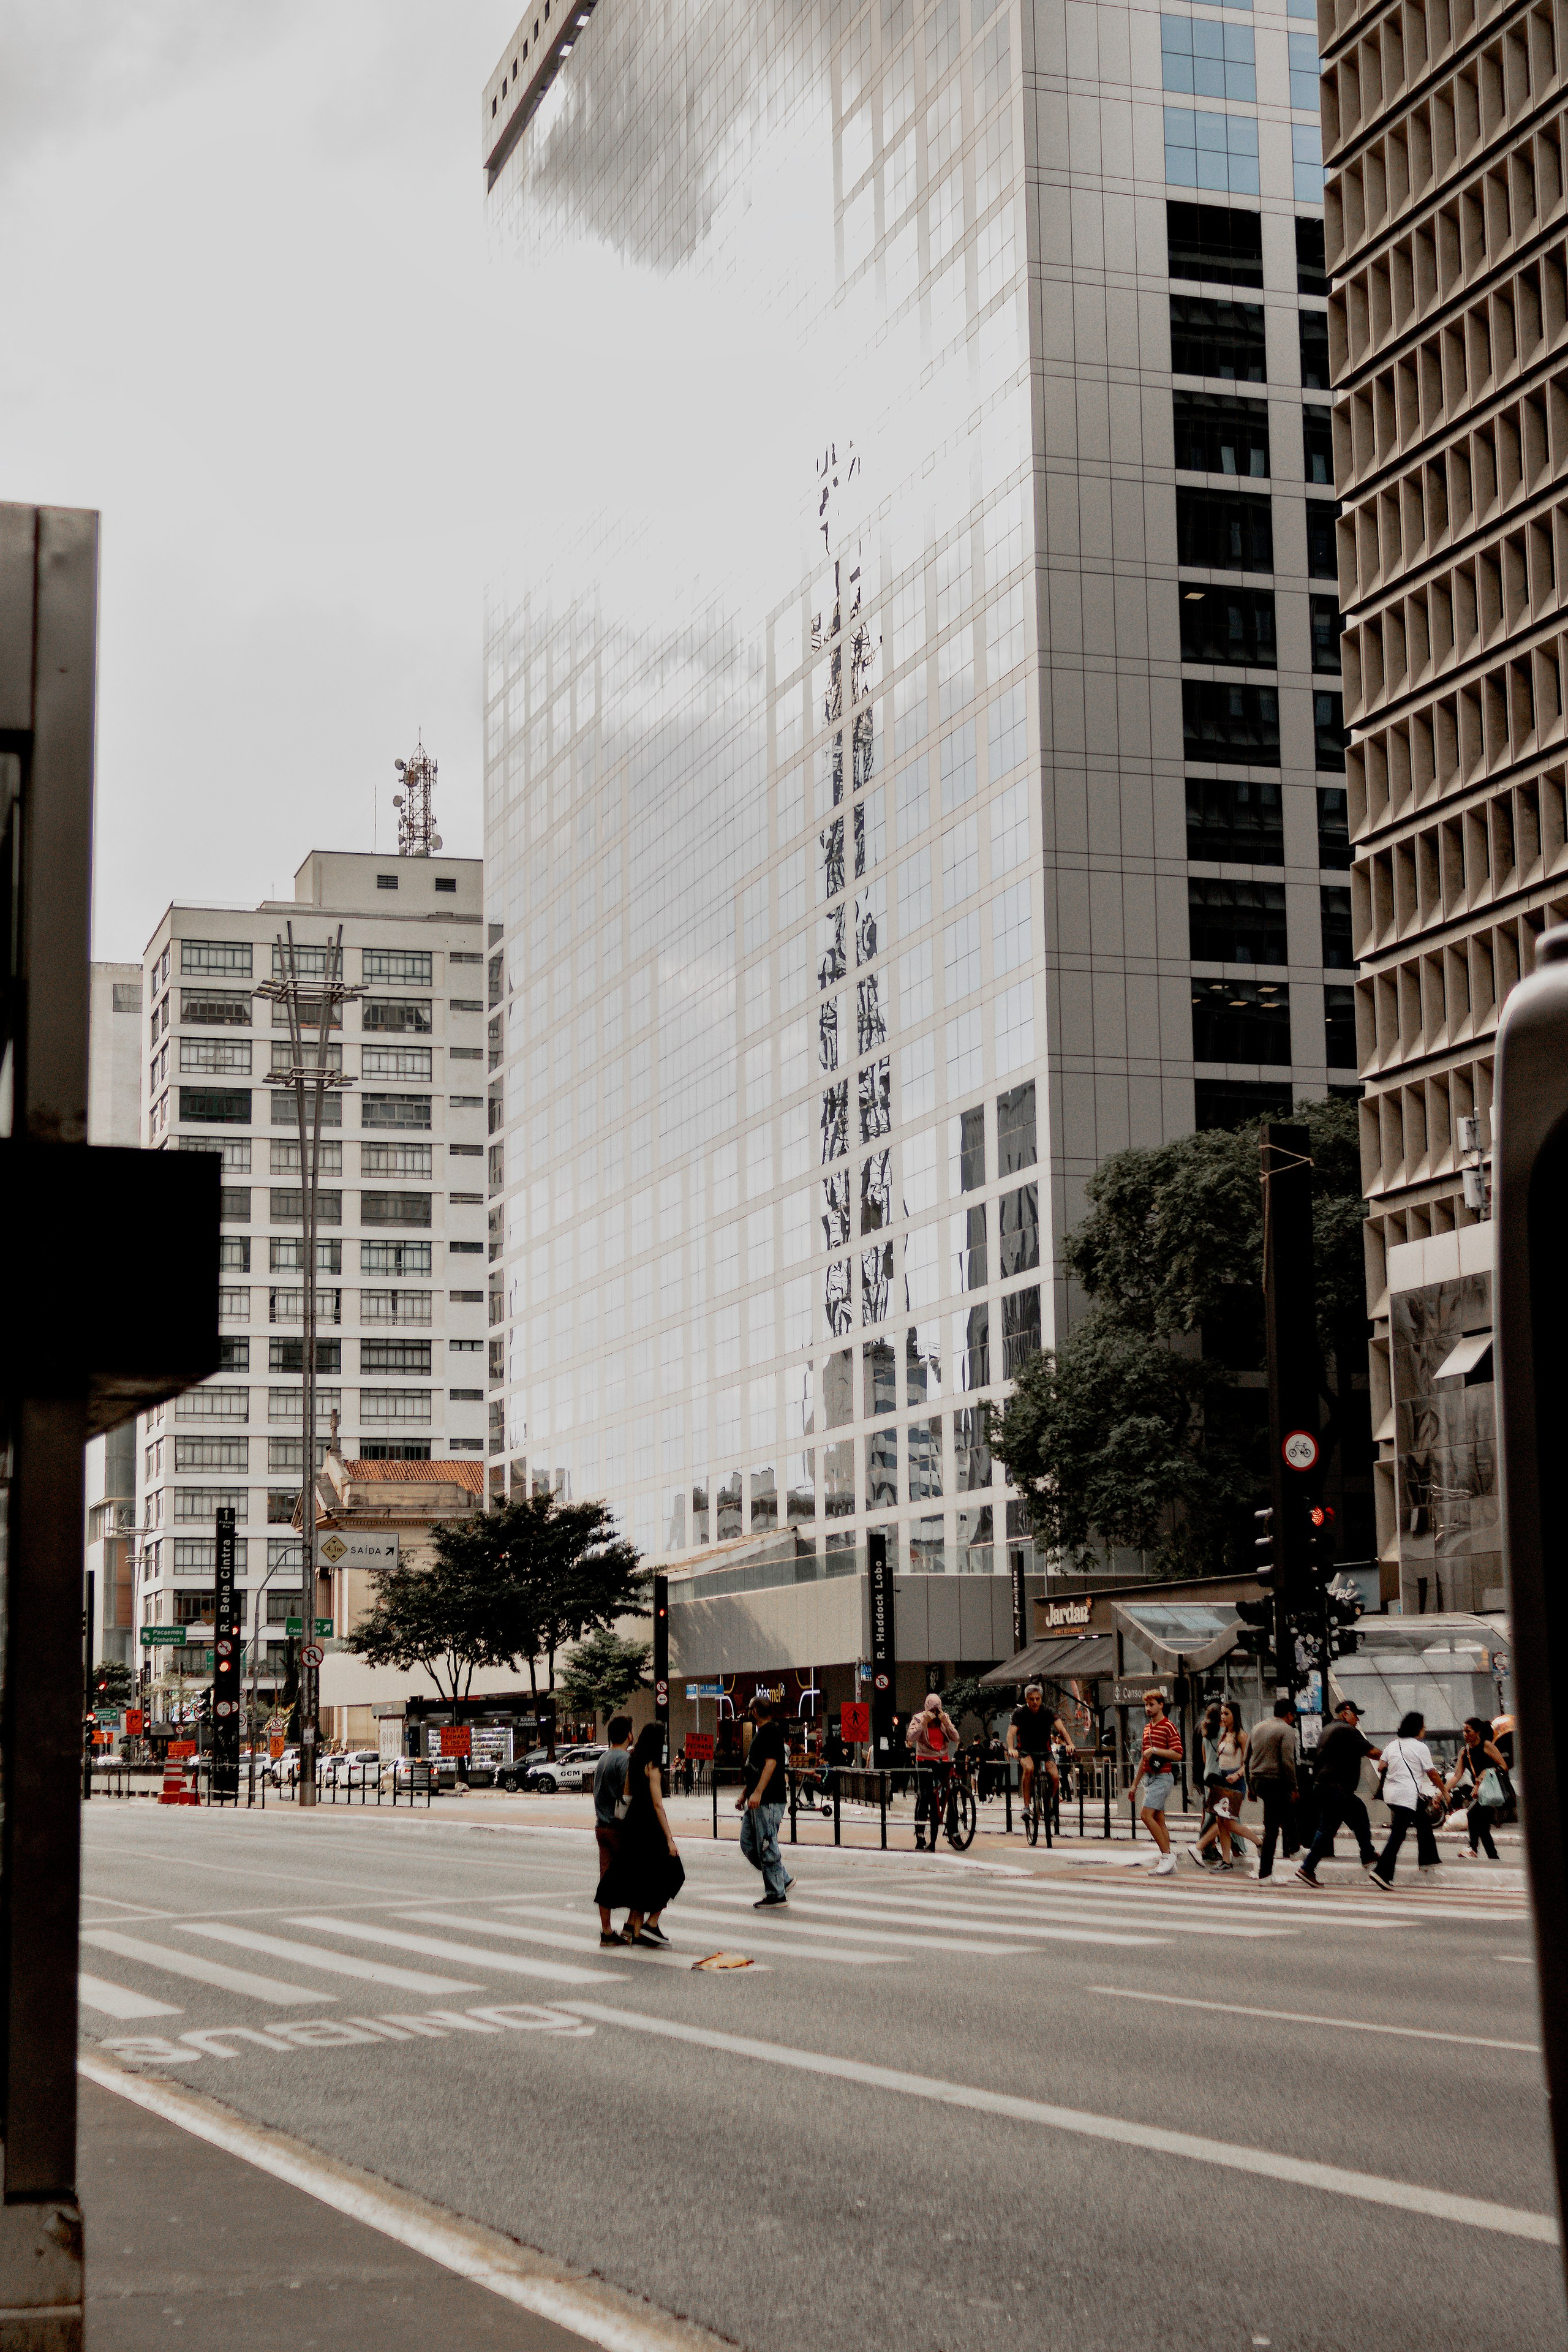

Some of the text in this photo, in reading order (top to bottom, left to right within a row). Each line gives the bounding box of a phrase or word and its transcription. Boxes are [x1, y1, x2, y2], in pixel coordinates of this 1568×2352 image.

[350, 1545, 381, 1555] SAÍDA
[220, 1539, 231, 1632] R. Bela Cintra
[874, 1561, 886, 1659] R. Haddock Lobo
[1045, 1602, 1090, 1627] Jardan
